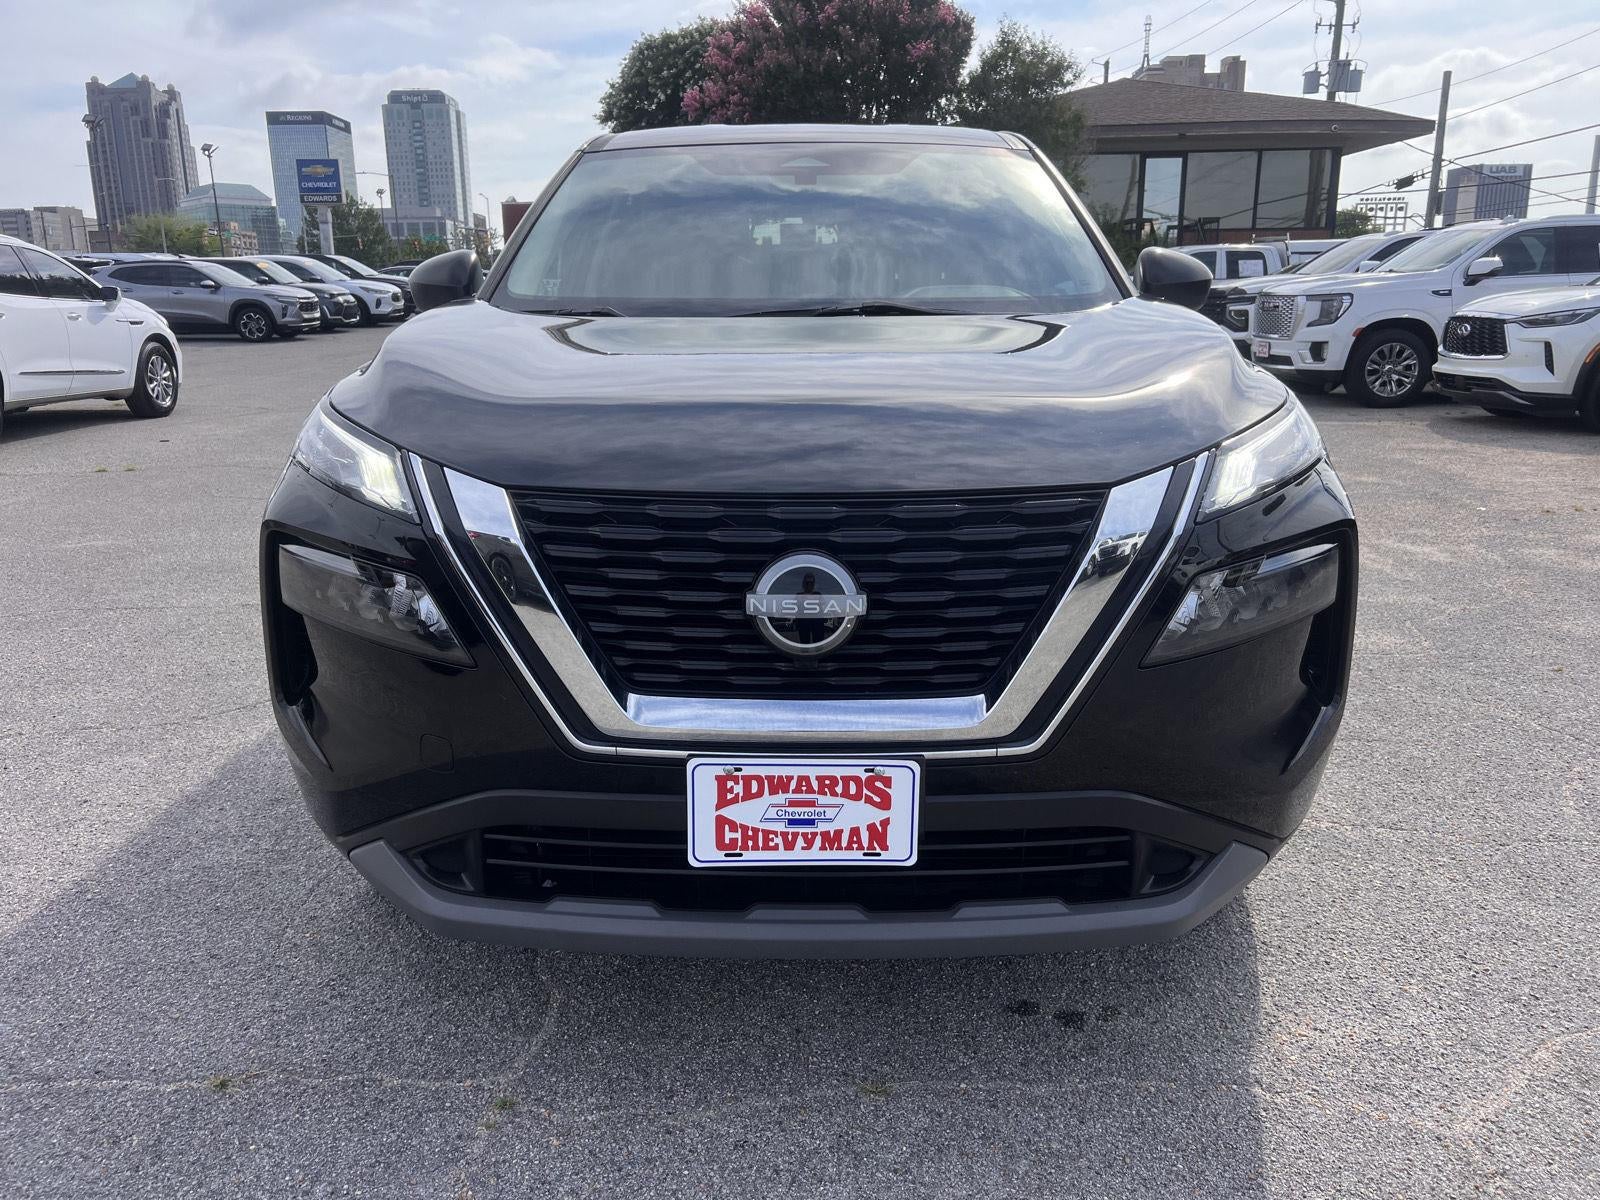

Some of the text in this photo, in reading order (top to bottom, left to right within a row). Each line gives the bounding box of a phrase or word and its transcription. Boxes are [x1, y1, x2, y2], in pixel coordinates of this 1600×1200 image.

[401, 94, 422, 103] Shipt
[1490, 165, 1517, 174] UAB
[750, 598, 863, 614] NISSAN
[715, 774, 892, 811] EDWARDS
[775, 808, 827, 818] Chevrolet
[715, 814, 890, 851] CHEVYMAN
